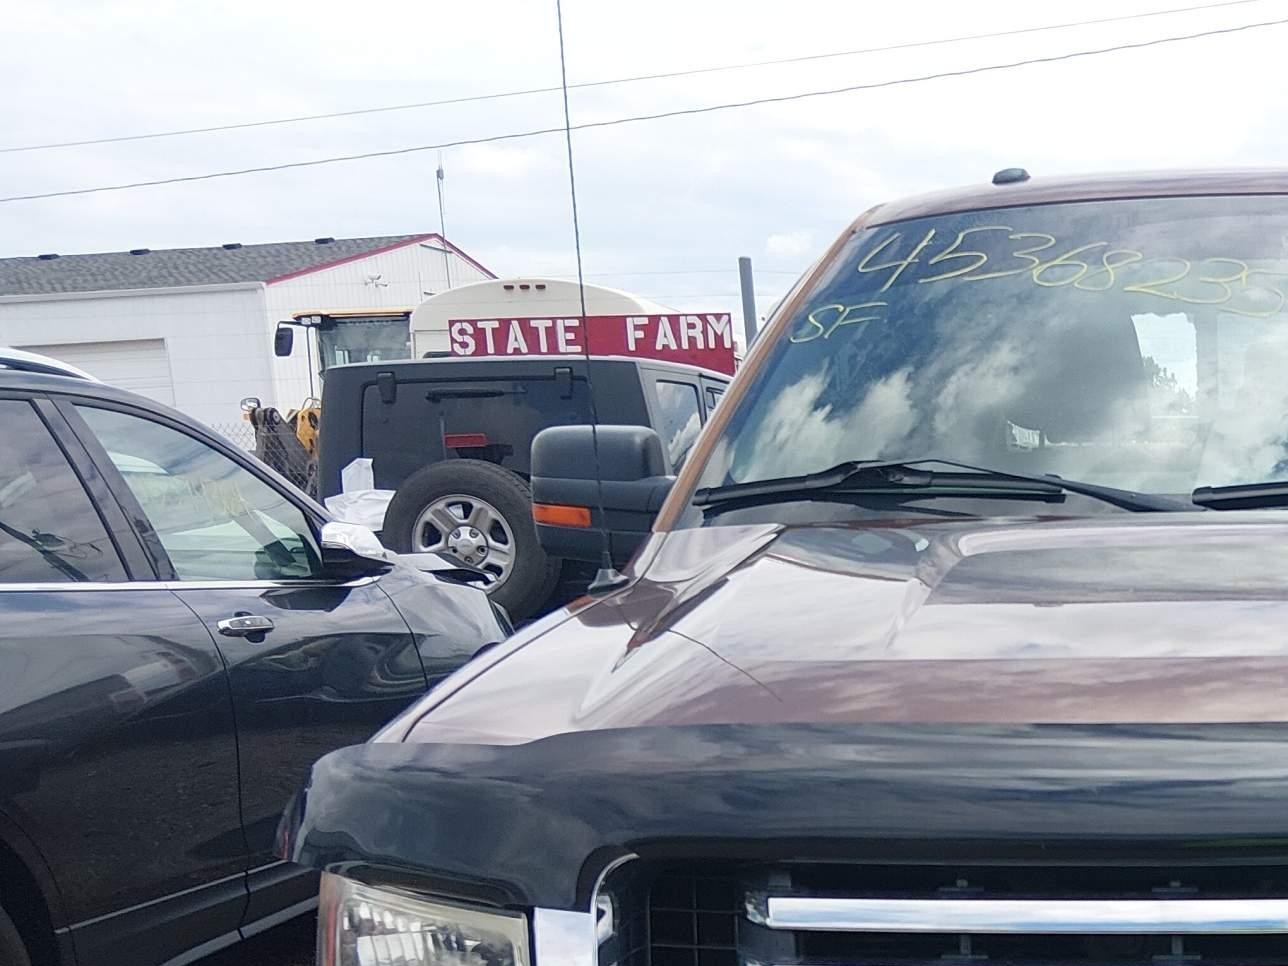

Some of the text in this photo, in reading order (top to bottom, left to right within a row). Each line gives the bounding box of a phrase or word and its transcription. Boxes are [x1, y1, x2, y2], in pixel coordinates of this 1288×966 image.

[451, 314, 732, 356] STATE FARM
[790, 302, 887, 343] SF
